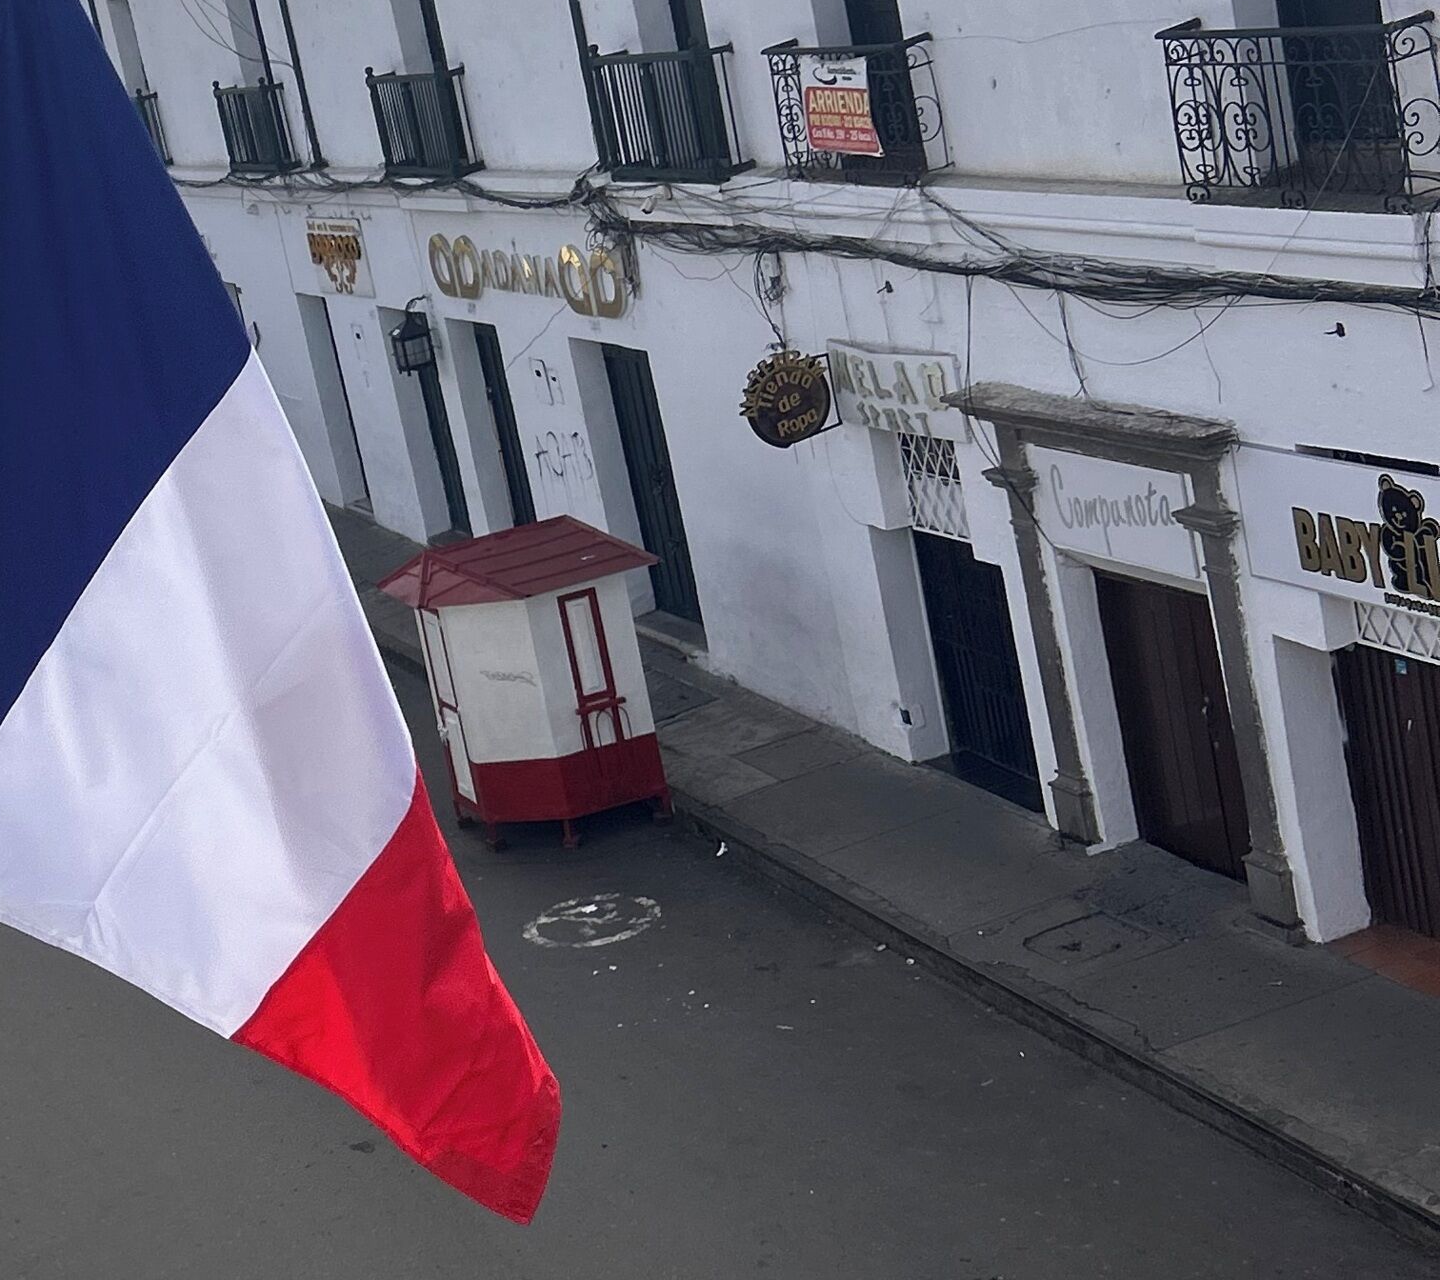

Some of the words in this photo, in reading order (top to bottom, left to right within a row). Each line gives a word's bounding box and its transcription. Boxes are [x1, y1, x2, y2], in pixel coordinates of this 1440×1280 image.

[757, 370, 814, 408] Tienda
[778, 392, 801, 413] de
[777, 408, 818, 437] Ropa
[1292, 506, 1386, 589] BABY
